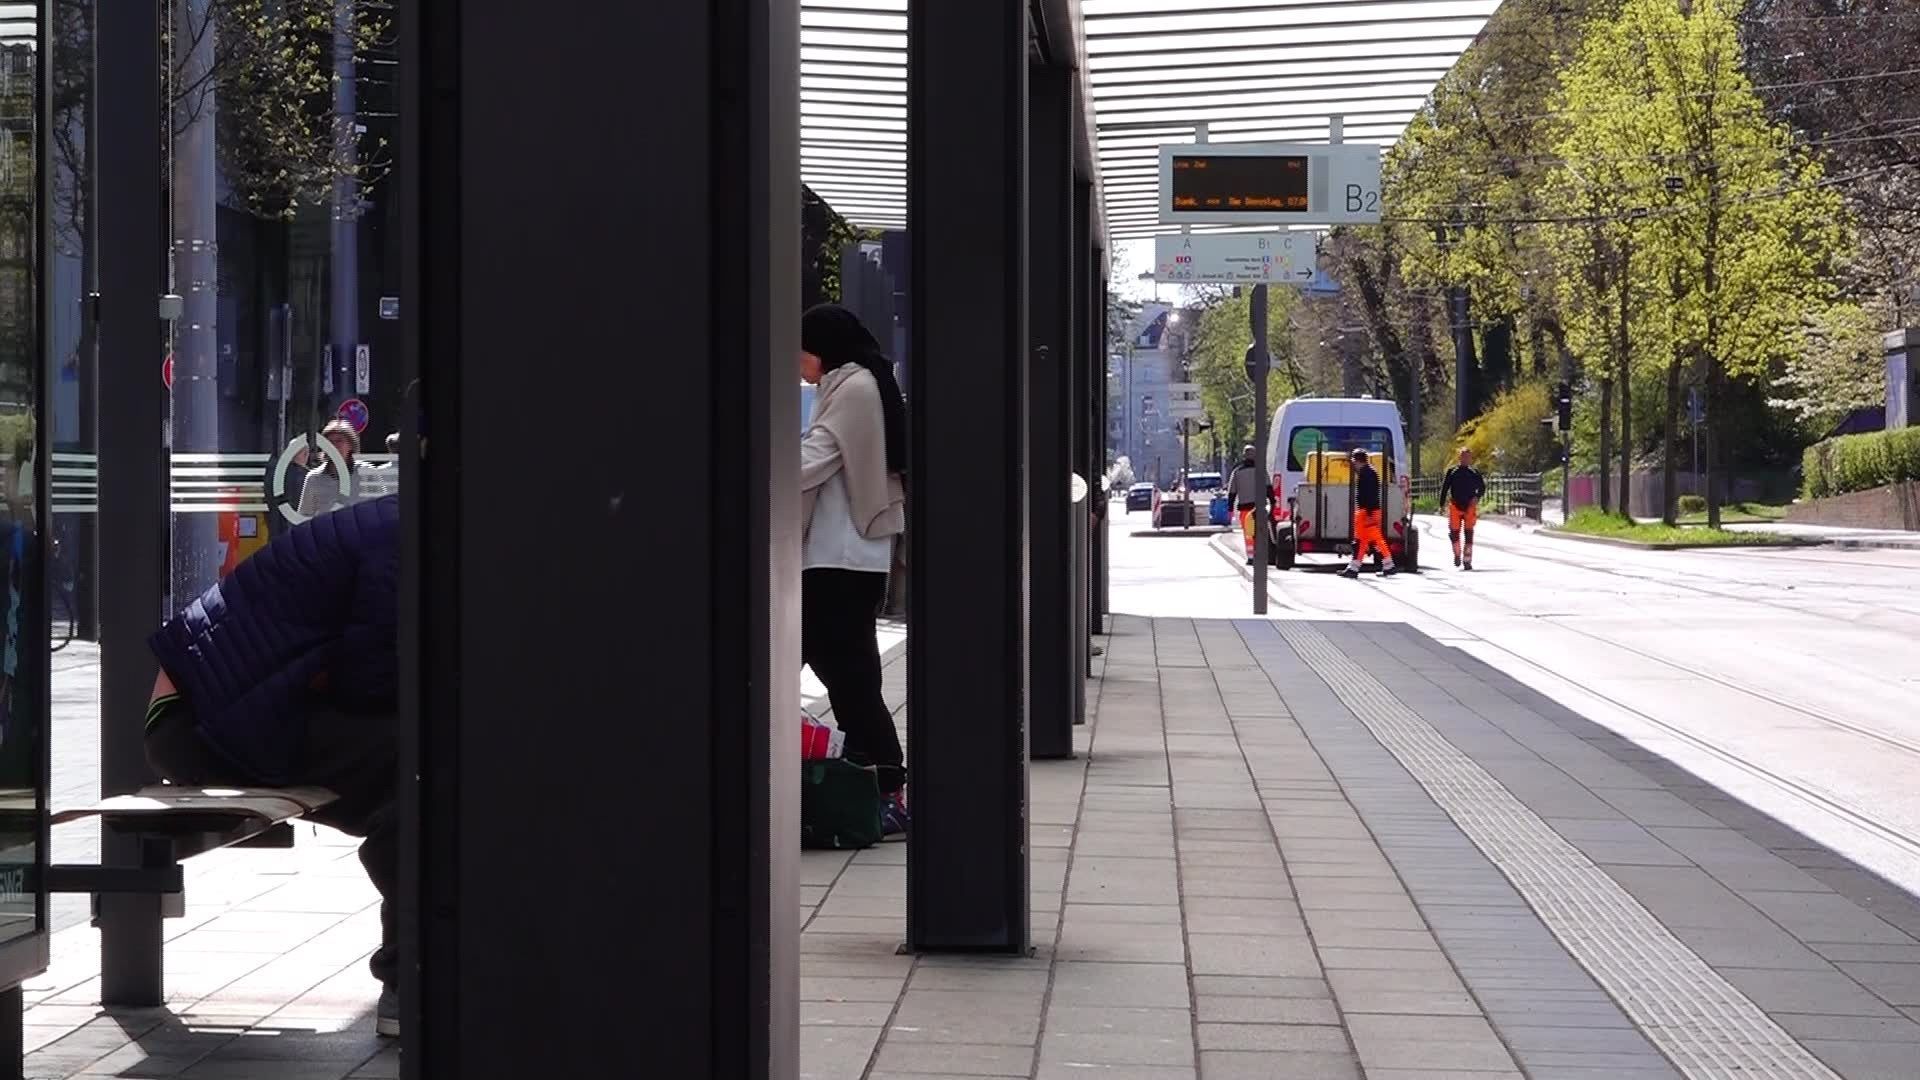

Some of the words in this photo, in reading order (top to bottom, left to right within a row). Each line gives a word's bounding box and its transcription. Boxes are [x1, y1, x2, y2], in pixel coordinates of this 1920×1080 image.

[1346, 184, 1378, 212] B2
[1183, 238, 1192, 250] A
[1283, 238, 1293, 250] C
